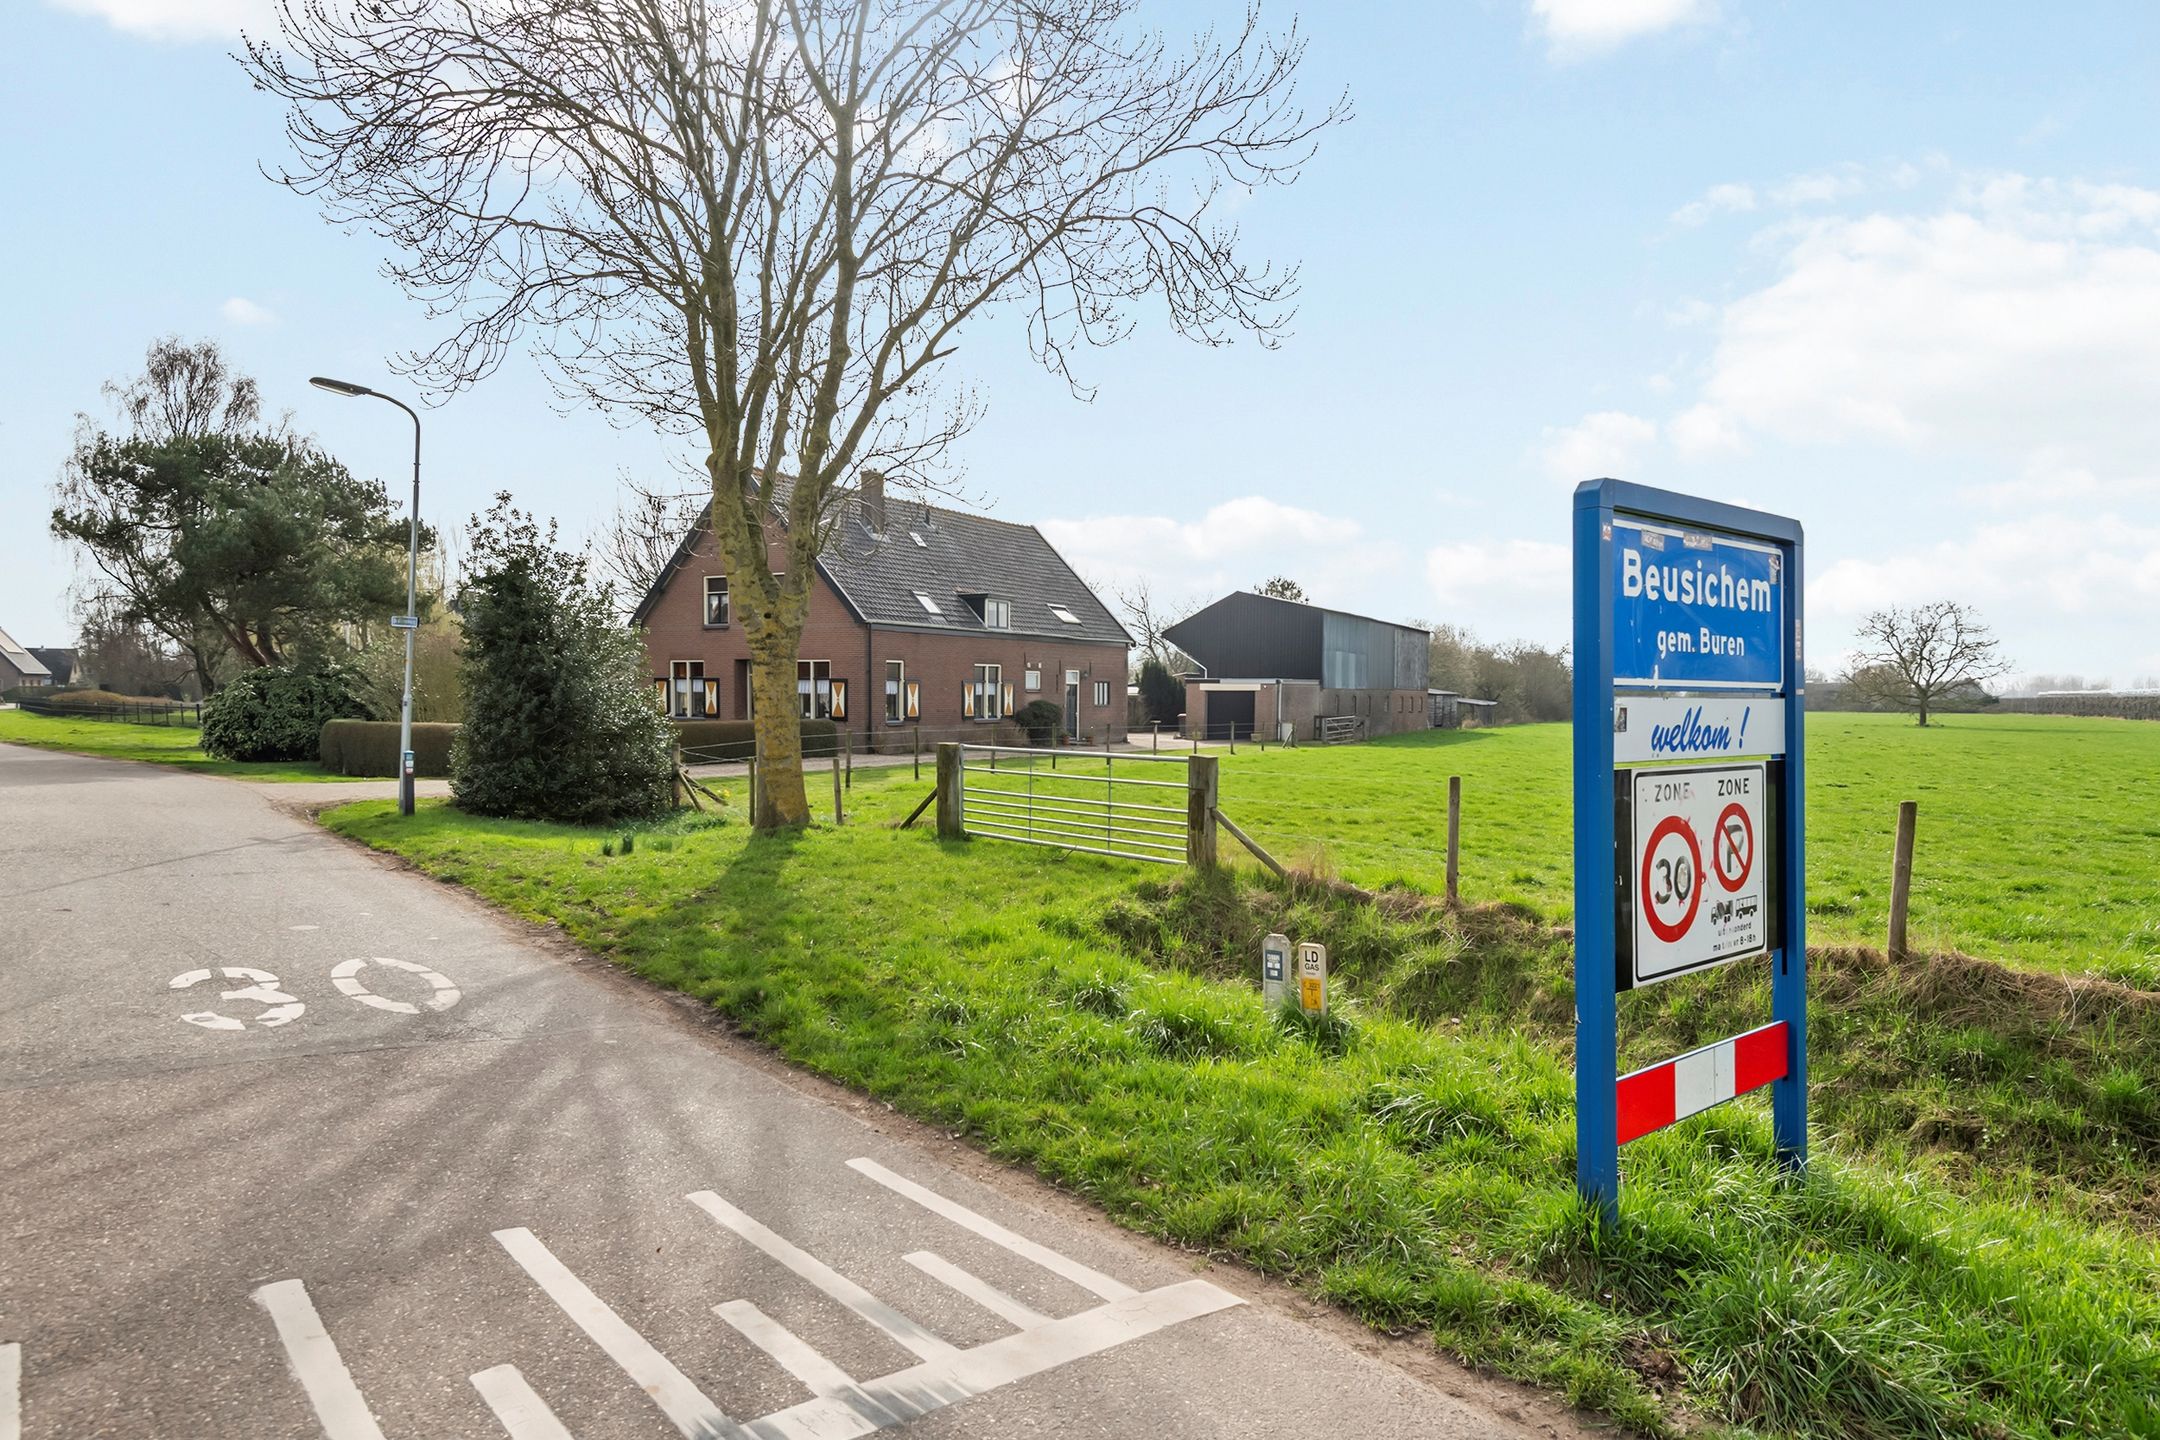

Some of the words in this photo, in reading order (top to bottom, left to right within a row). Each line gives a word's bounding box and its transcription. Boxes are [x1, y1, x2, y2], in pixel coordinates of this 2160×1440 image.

[1622, 548, 1771, 612] Beusichem
[1657, 627, 1696, 659] gem.
[1699, 627, 1745, 656] Buren
[1651, 705, 1731, 752] welkom
[1654, 782, 1690, 802] ZONE
[1718, 778, 1750, 796] ZONE
[1655, 855, 1692, 905] 30
[1304, 950, 1318, 963] LD
[1304, 963, 1319, 971] GAS
[169, 957, 462, 1030] 30
